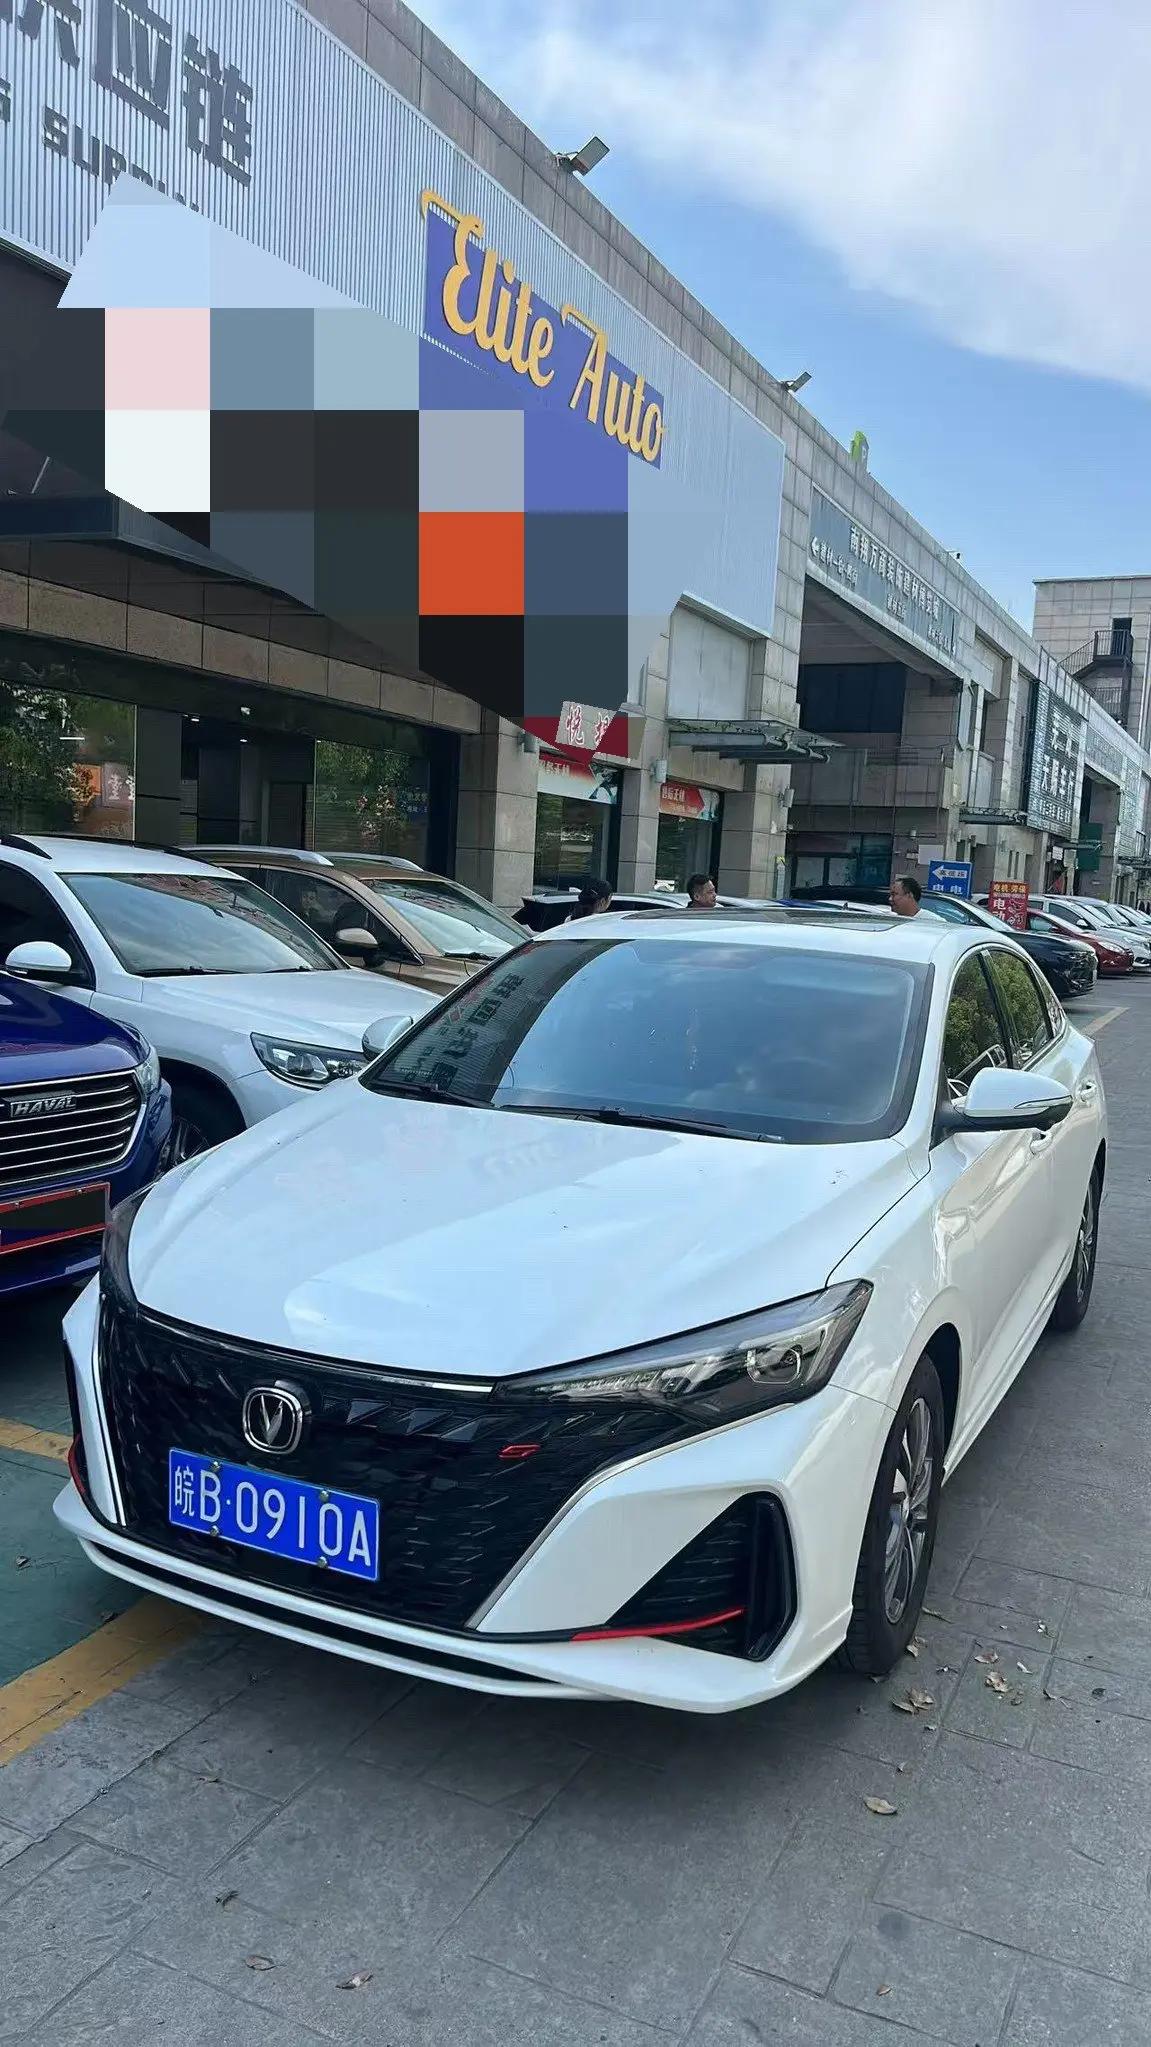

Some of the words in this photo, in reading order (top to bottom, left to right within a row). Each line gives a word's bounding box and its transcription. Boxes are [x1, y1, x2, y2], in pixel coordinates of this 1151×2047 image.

[420, 187, 555, 388] Elite
[560, 303, 668, 462] Auto
[14, 1095, 76, 1116] HAVAL
